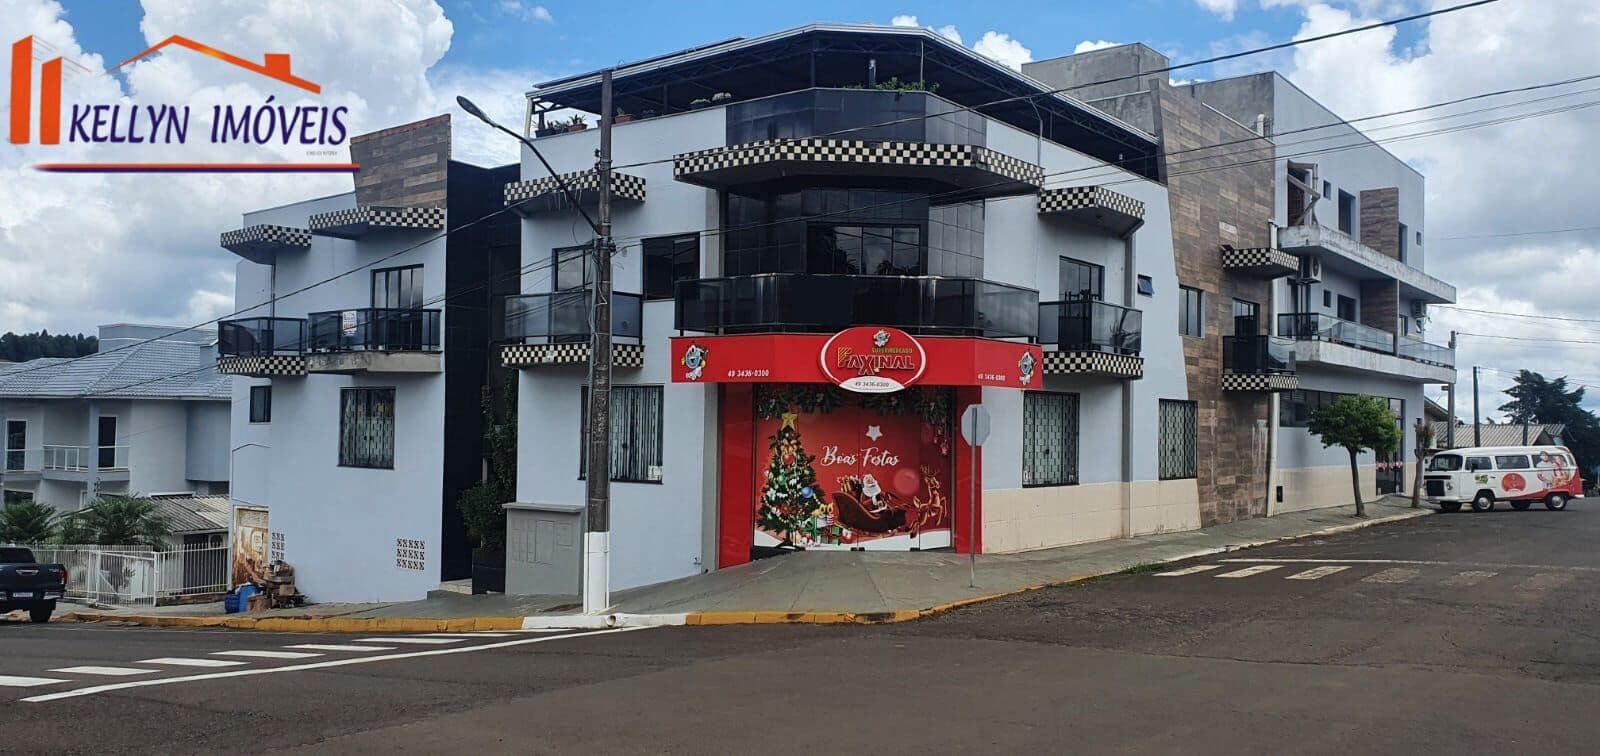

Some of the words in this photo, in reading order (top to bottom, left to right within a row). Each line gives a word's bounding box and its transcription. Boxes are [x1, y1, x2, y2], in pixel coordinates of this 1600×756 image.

[837, 347, 915, 376] FAXINAL
[728, 369, 736, 377] 49
[821, 445, 857, 467] Boas
[861, 446, 900, 467] Festas
